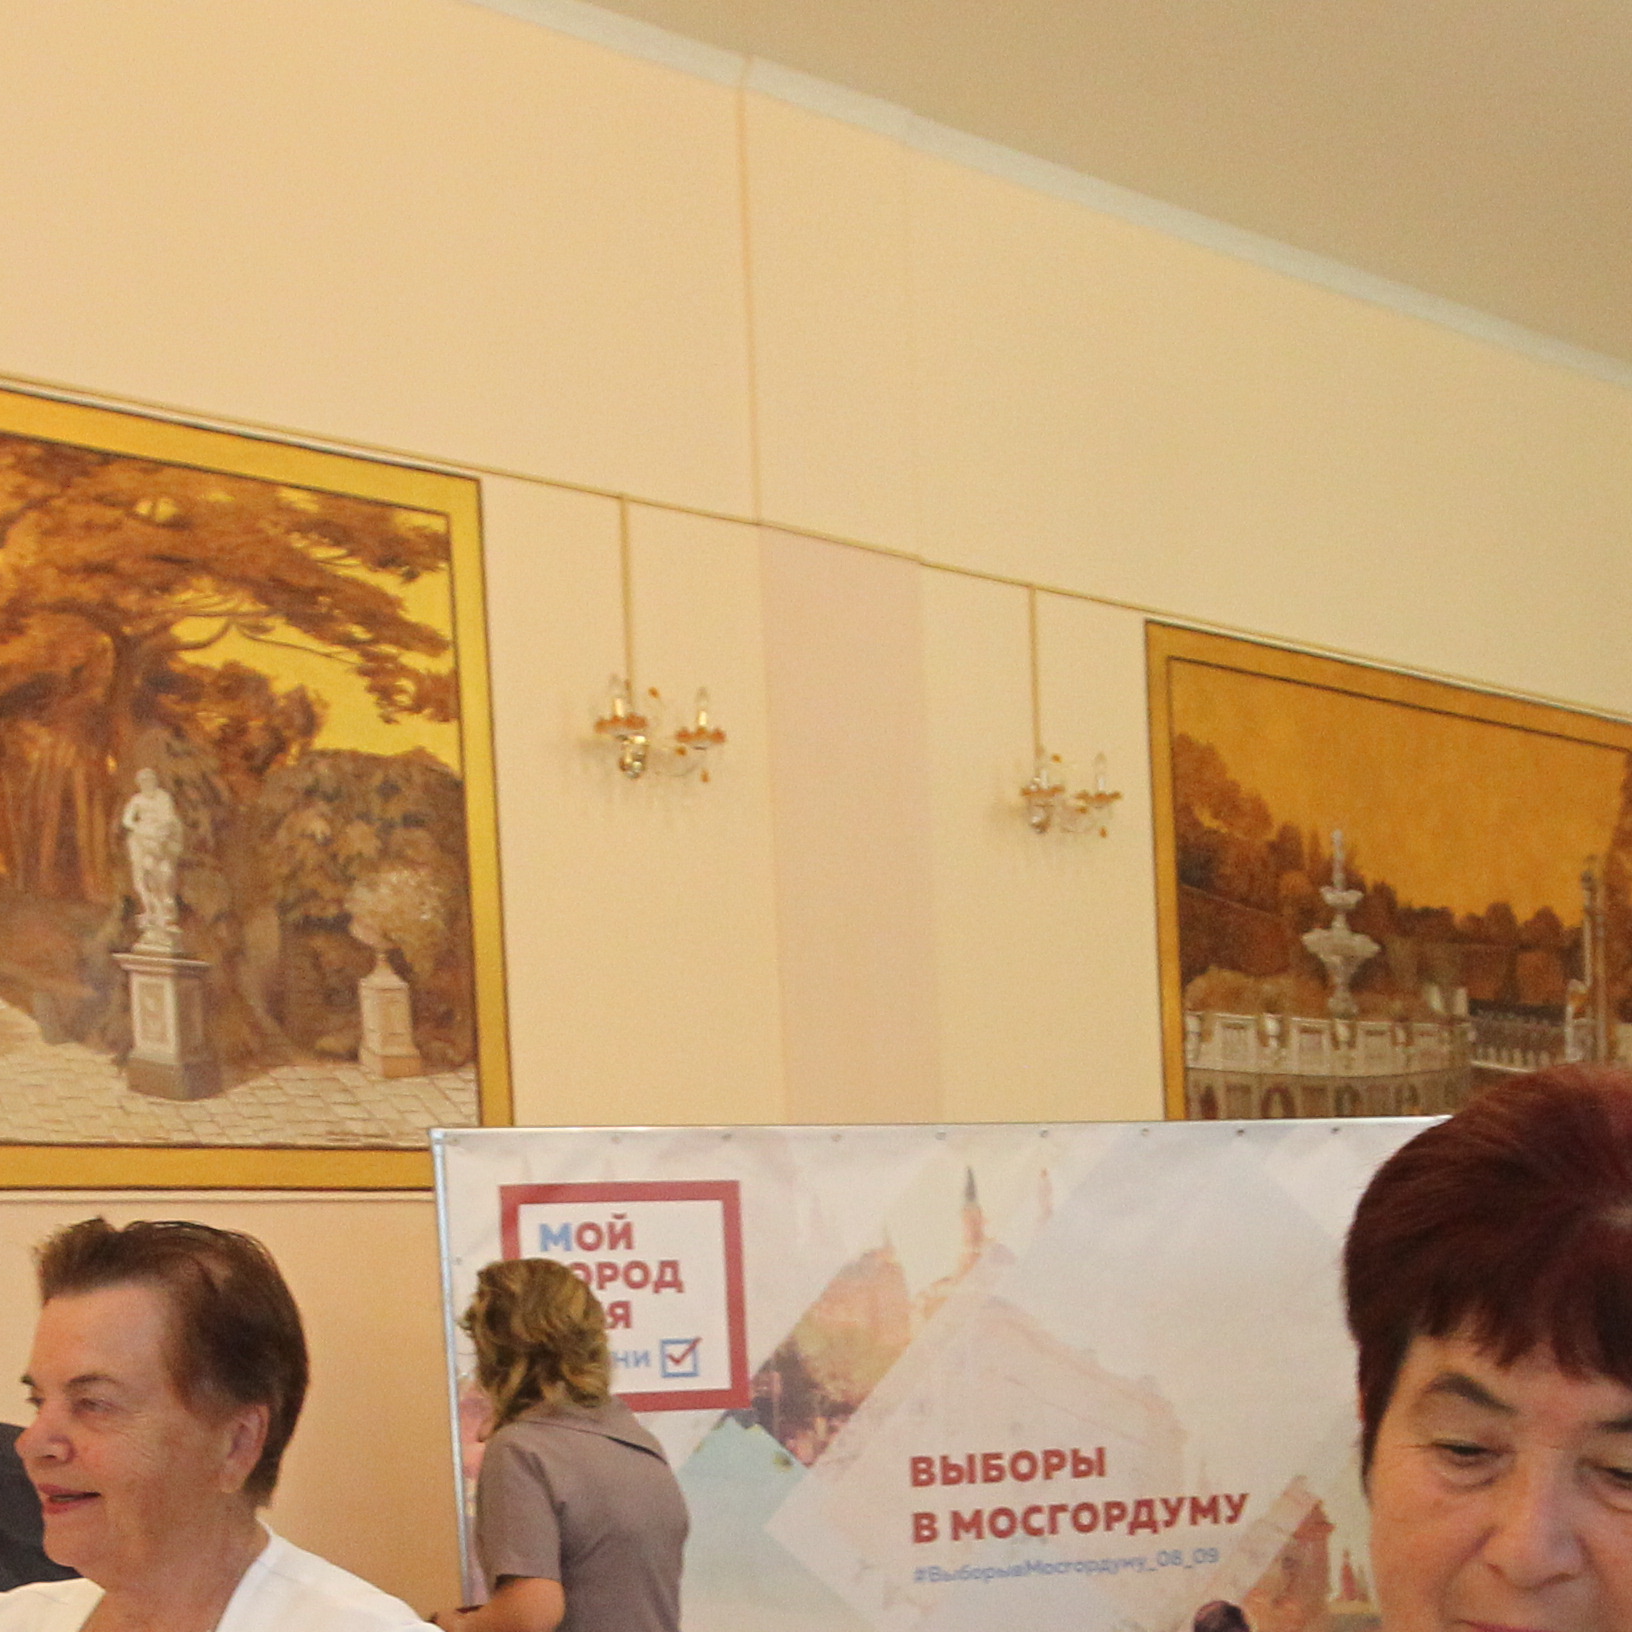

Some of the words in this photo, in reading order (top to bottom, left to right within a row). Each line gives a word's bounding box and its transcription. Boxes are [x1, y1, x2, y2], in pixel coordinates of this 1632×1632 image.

[539, 1212, 635, 1252] МОЙ
[569, 1260, 685, 1294] ОРОД
[910, 1447, 1107, 1487] ВЫБОРЫ
[911, 1511, 939, 1544] В
[950, 1493, 1250, 1542] МОСГОРДУМУ
